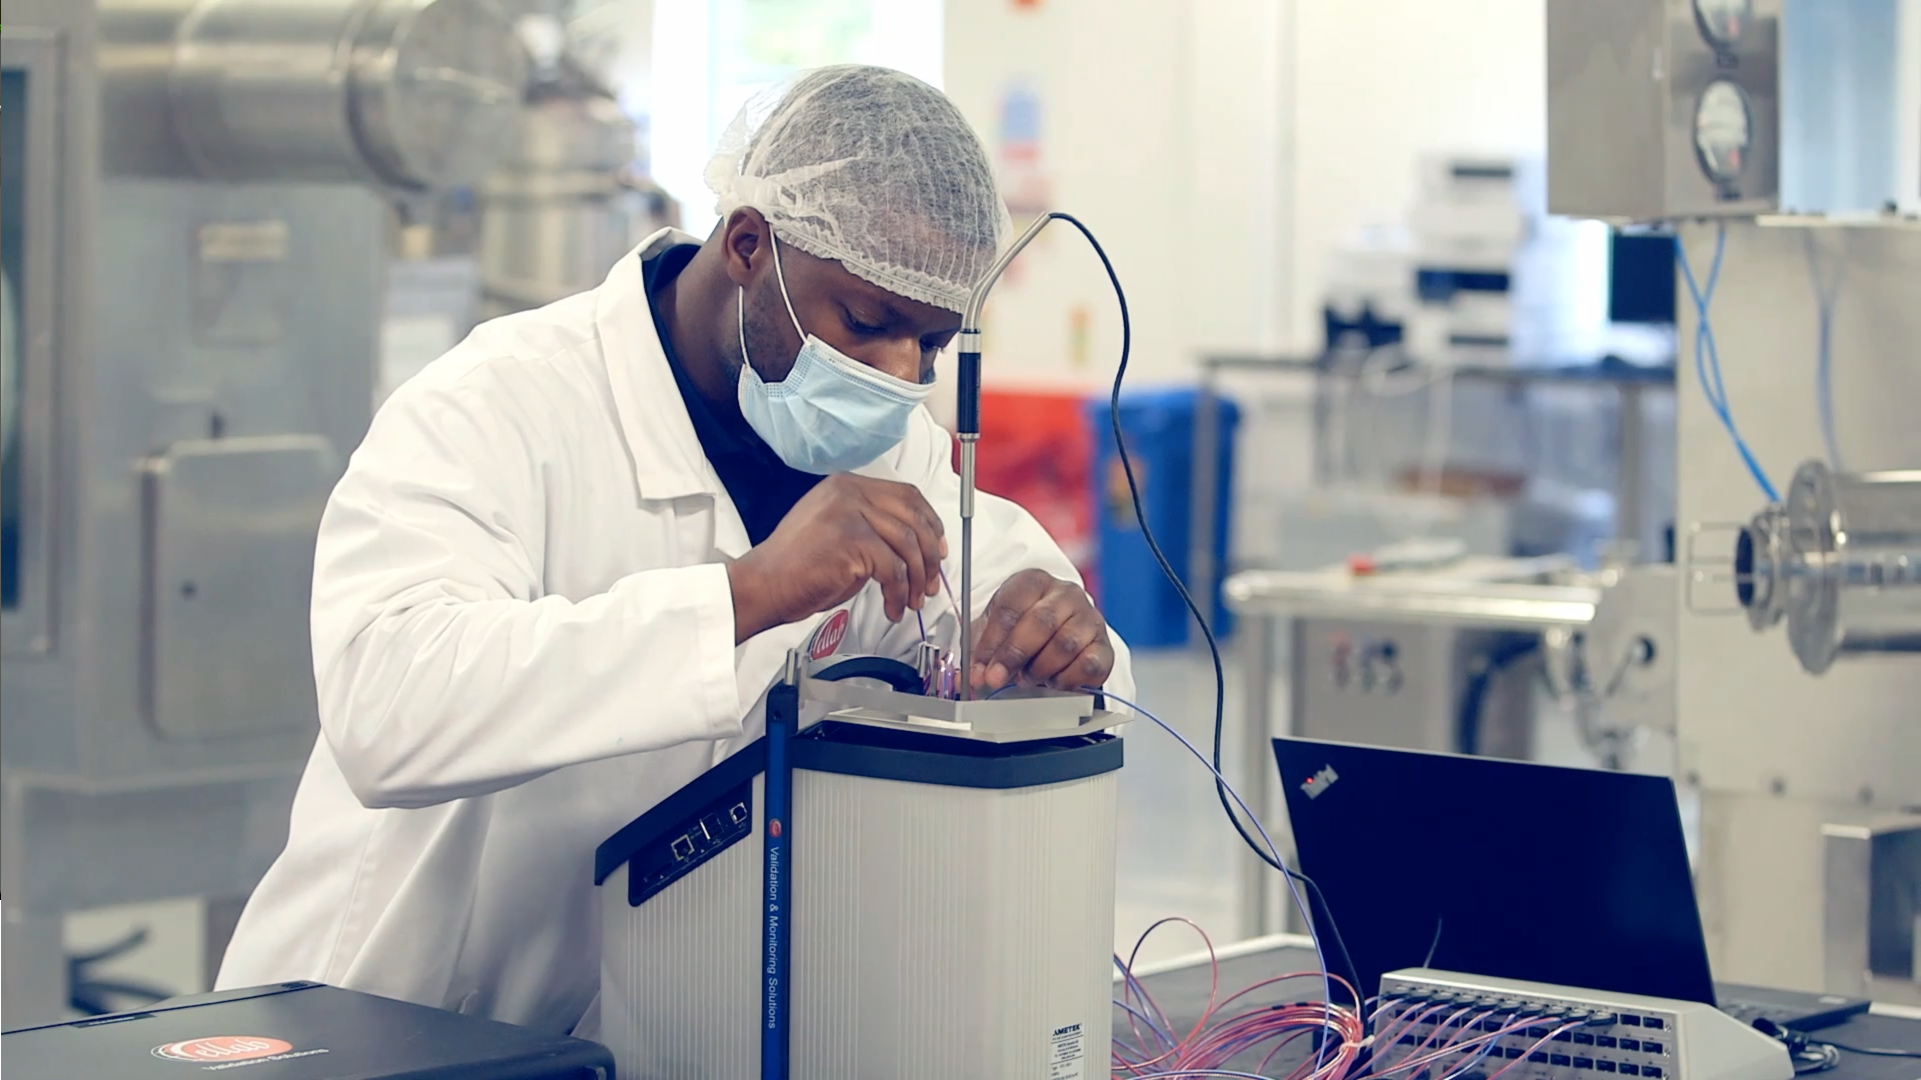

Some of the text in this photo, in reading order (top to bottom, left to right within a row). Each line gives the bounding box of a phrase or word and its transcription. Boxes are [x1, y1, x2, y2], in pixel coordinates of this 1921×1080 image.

[769, 846, 780, 901] Validation
[769, 903, 780, 912] &
[766, 915, 779, 974] Monitoring
[768, 977, 779, 1029] Solutions
[1053, 1023, 1081, 1036] AMETEK
[194, 1038, 270, 1058] ellab
